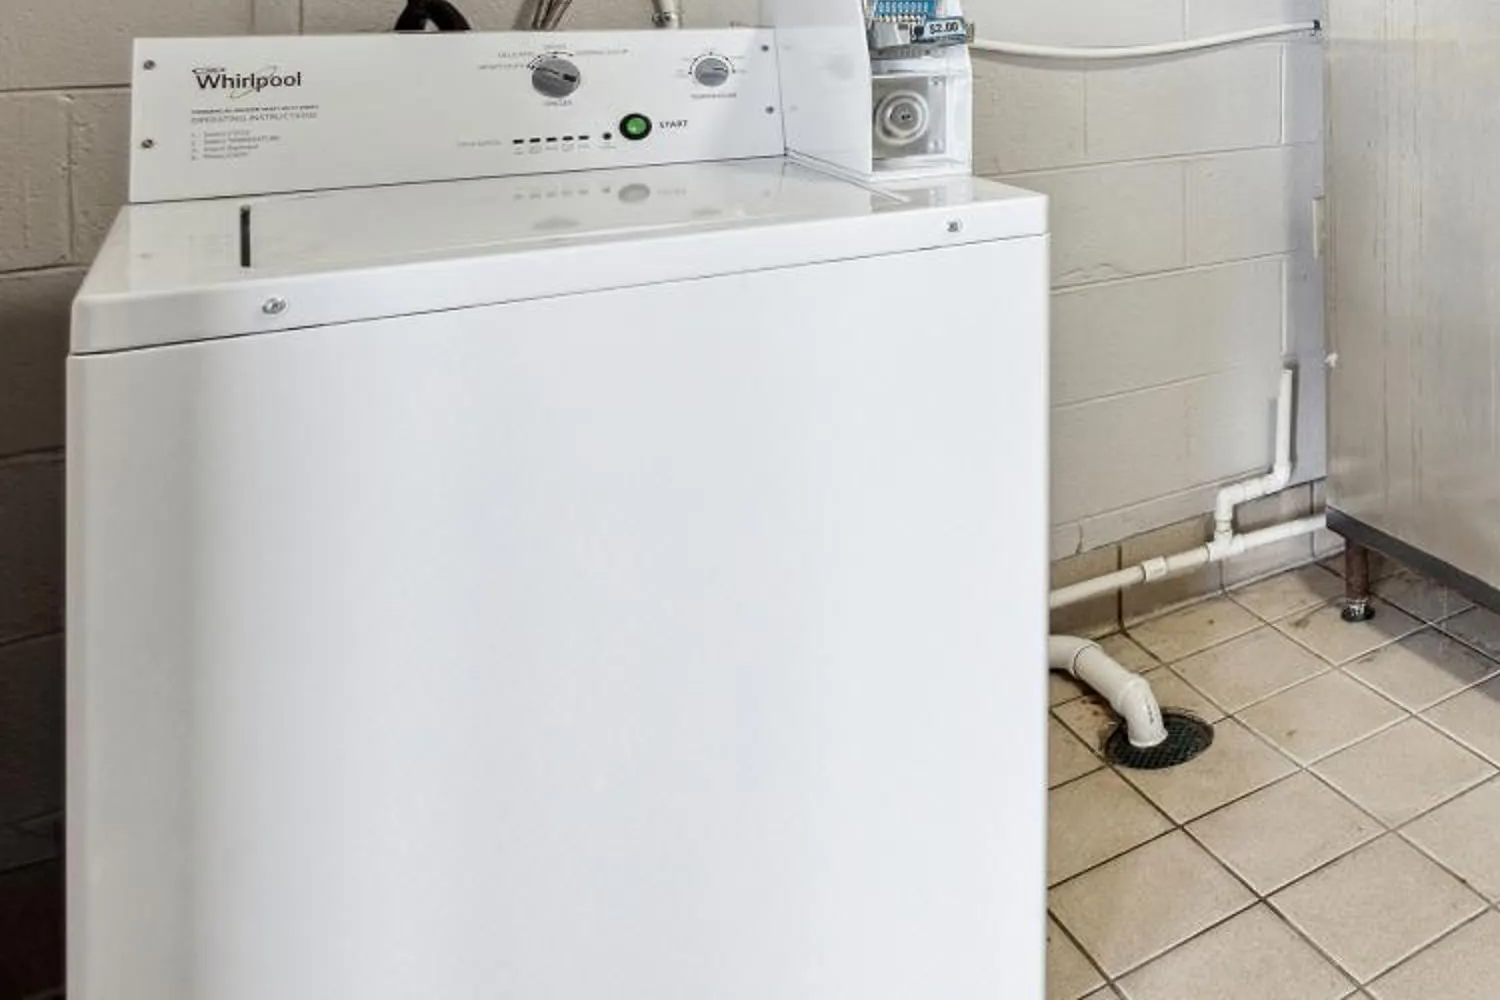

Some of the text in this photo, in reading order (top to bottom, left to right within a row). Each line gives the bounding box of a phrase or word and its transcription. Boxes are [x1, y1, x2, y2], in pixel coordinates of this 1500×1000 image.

[929, 21, 959, 35] $2.00
[196, 71, 301, 93] Whirlpool
[658, 119, 689, 129] START
